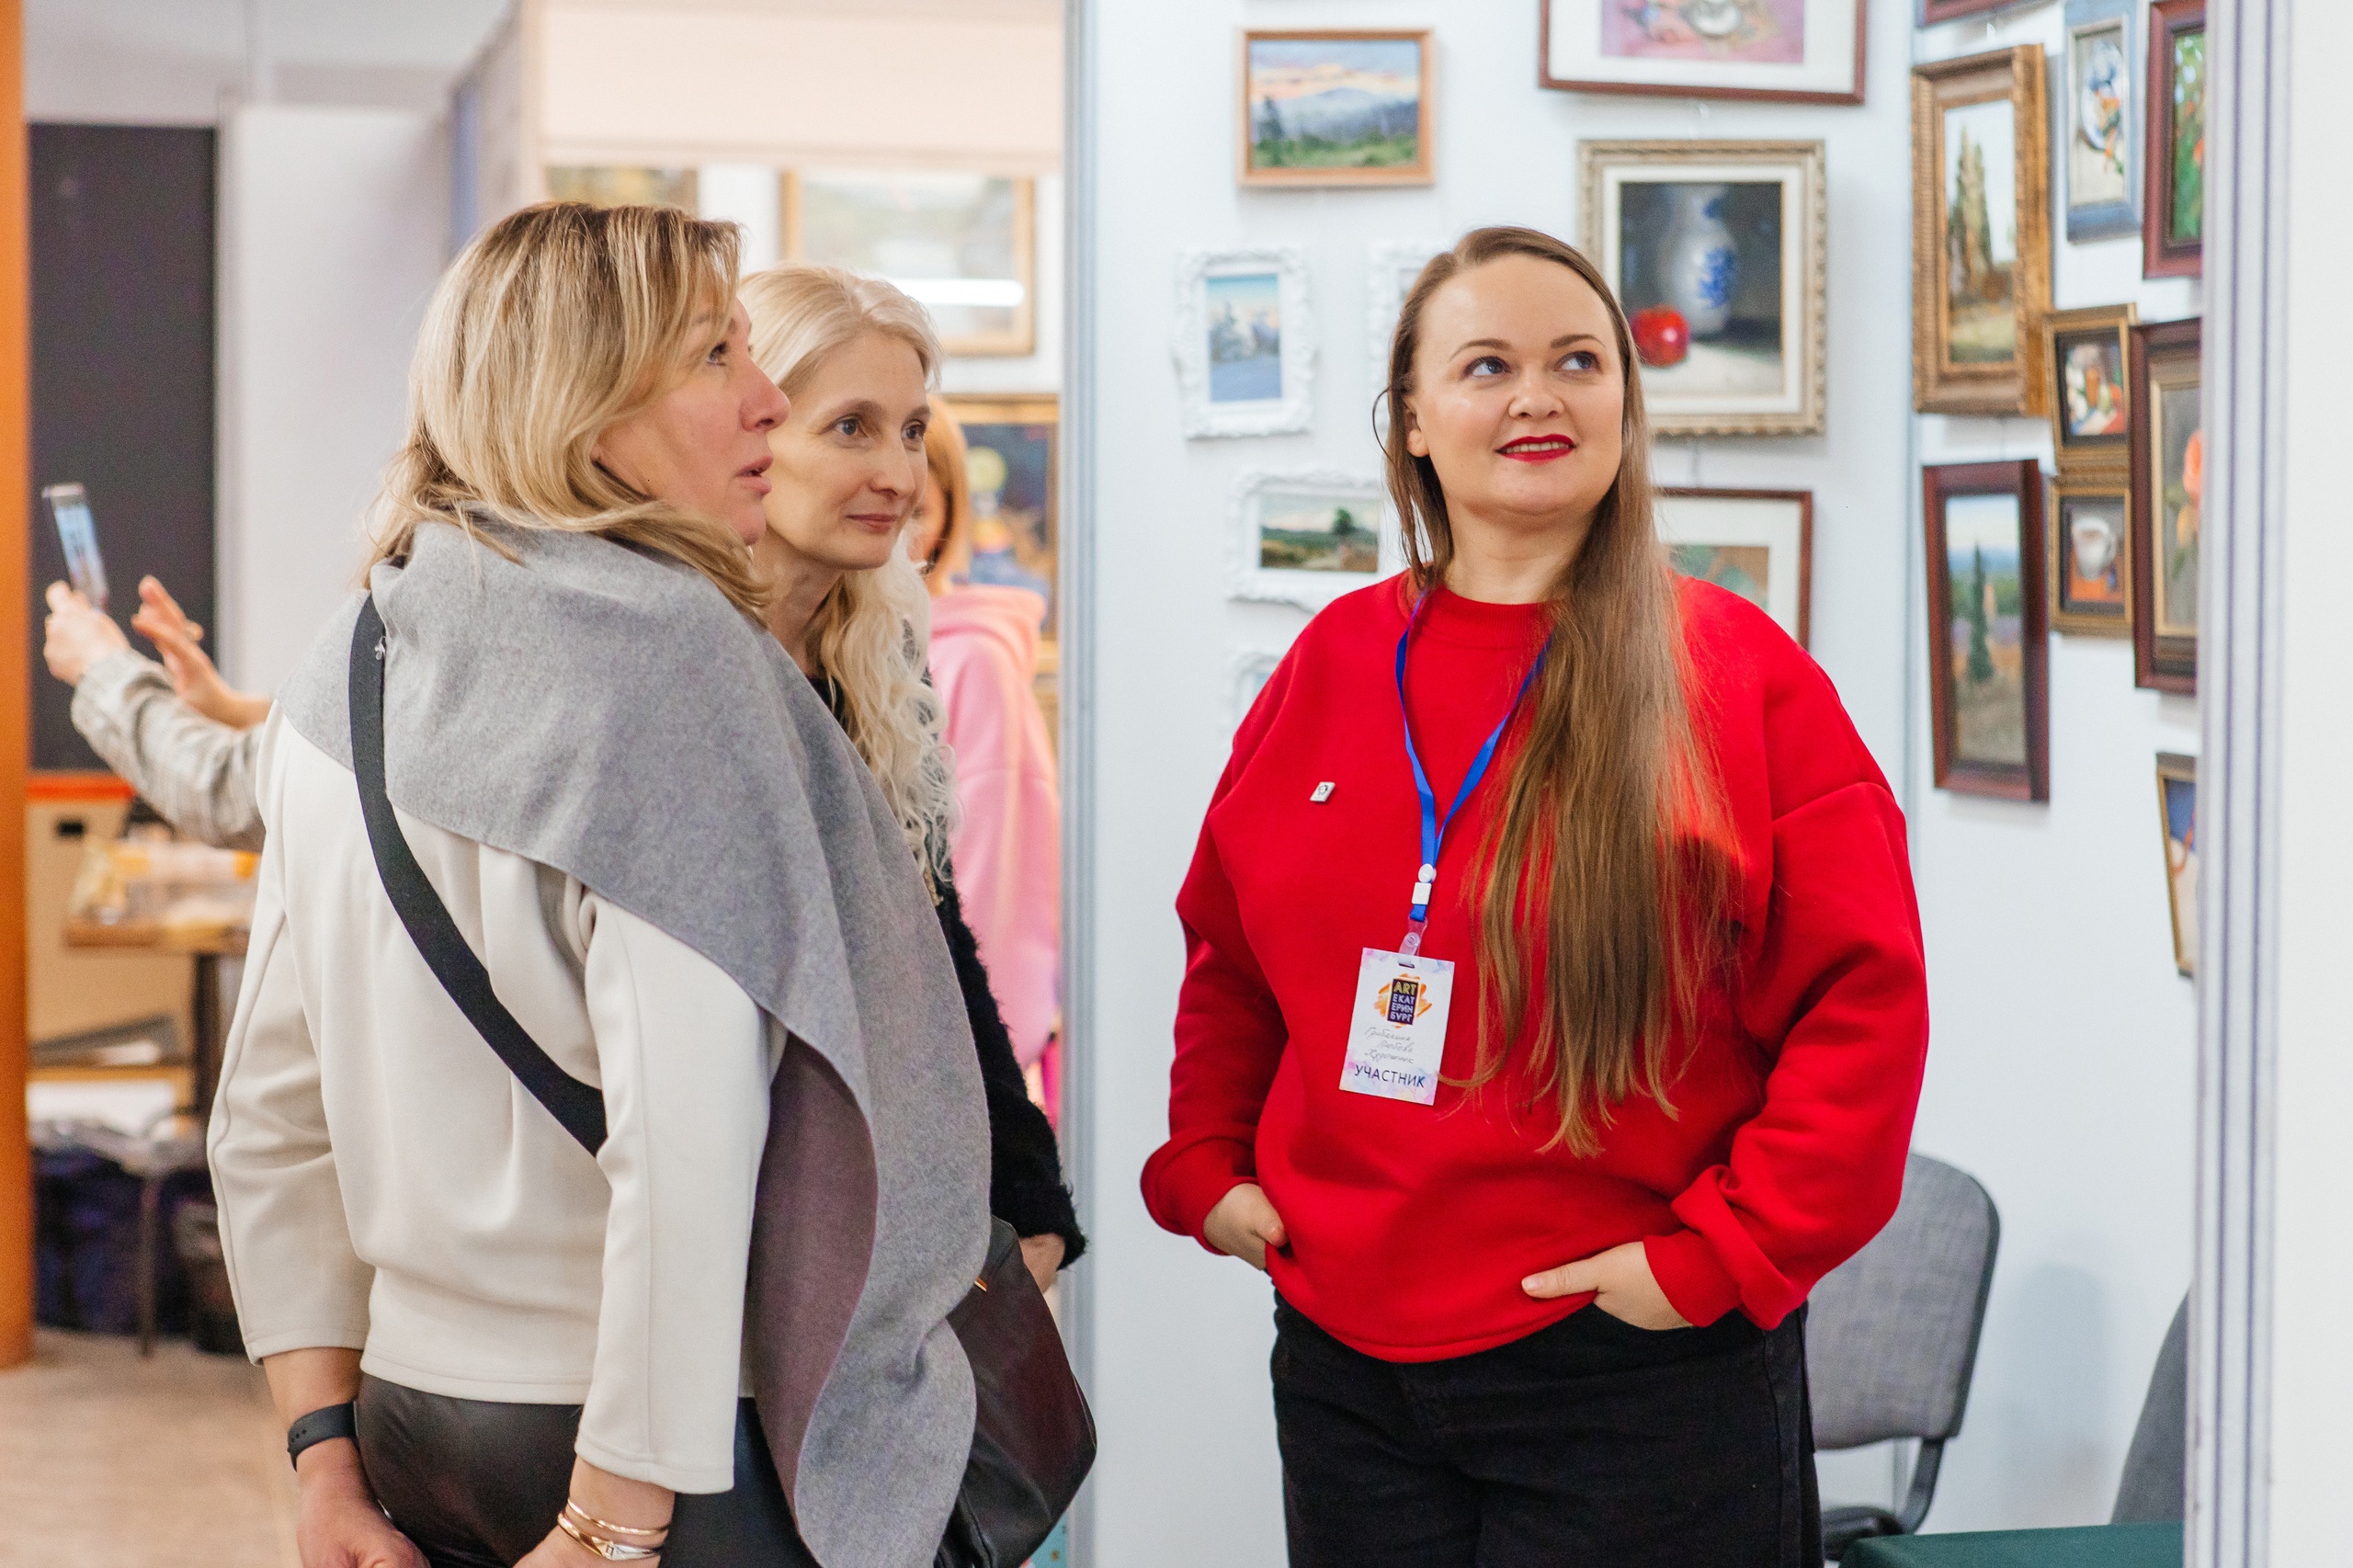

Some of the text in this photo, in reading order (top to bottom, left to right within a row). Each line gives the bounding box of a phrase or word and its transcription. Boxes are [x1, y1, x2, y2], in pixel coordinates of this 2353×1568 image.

[1393, 981, 1416, 995] ART
[1392, 993, 1415, 1005] ЕКАТ
[1391, 1002, 1414, 1015] ЕРИН
[1390, 1011, 1413, 1023] БУРГ
[1354, 1063, 1426, 1088] УЧАСТНИК
